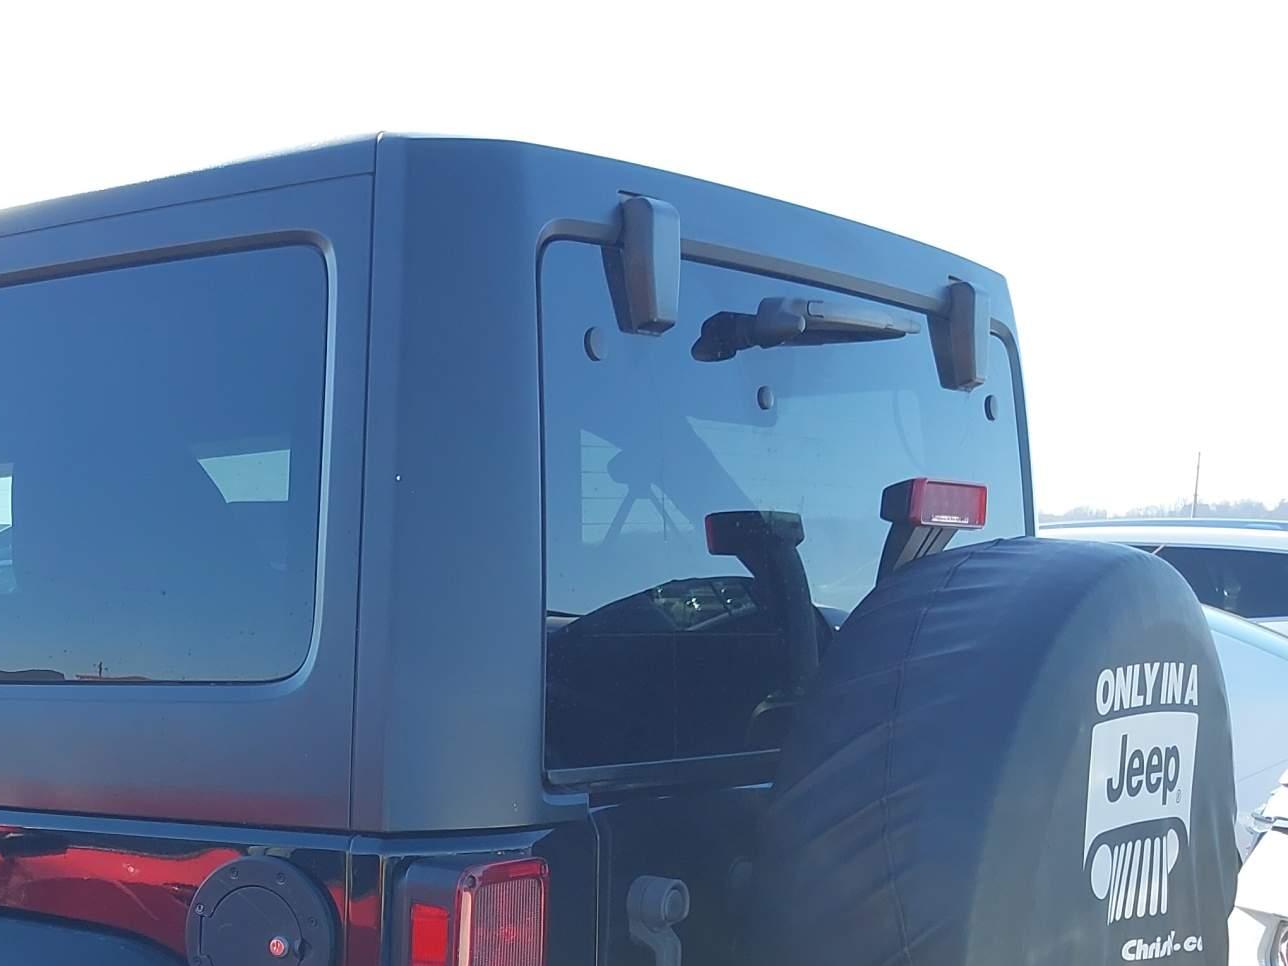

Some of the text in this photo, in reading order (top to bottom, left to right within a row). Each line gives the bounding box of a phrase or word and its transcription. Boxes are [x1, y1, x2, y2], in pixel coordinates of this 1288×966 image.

[1096, 662, 1199, 716] ONLY IN A
[1106, 733, 1181, 806] Jeep
